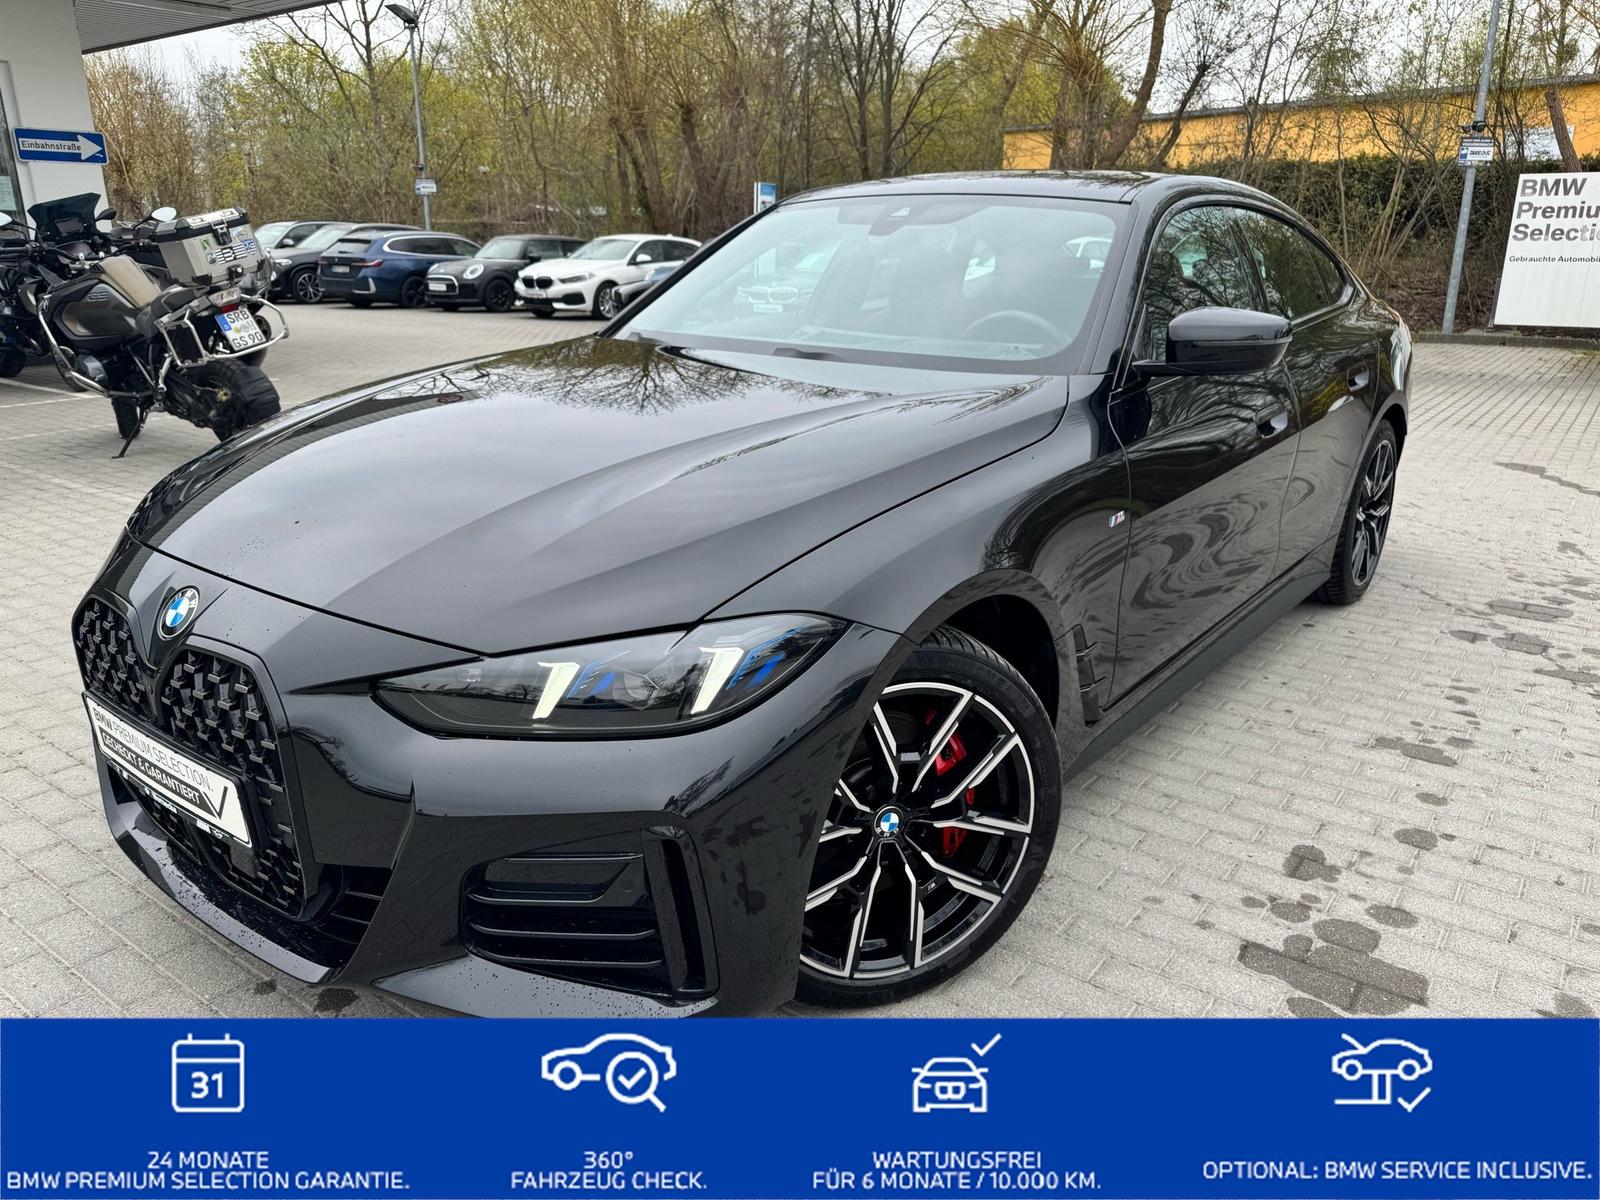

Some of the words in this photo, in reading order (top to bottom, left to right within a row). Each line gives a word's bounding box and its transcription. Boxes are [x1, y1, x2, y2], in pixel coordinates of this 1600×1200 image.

[21, 140, 81, 151] Einbahnstraße
[1520, 178, 1587, 197] BMW
[1516, 201, 1600, 219] Premiu
[1509, 255, 1556, 263] Gebrauchte
[226, 310, 250, 323] SRB
[232, 336, 248, 348] GS
[248, 331, 263, 343] 90
[93, 707, 113, 731] BMW
[112, 721, 153, 758] PREMIUM
[102, 732, 137, 766] GECHECKT
[138, 758, 146, 771] &
[145, 762, 200, 804] GARANTIERT
